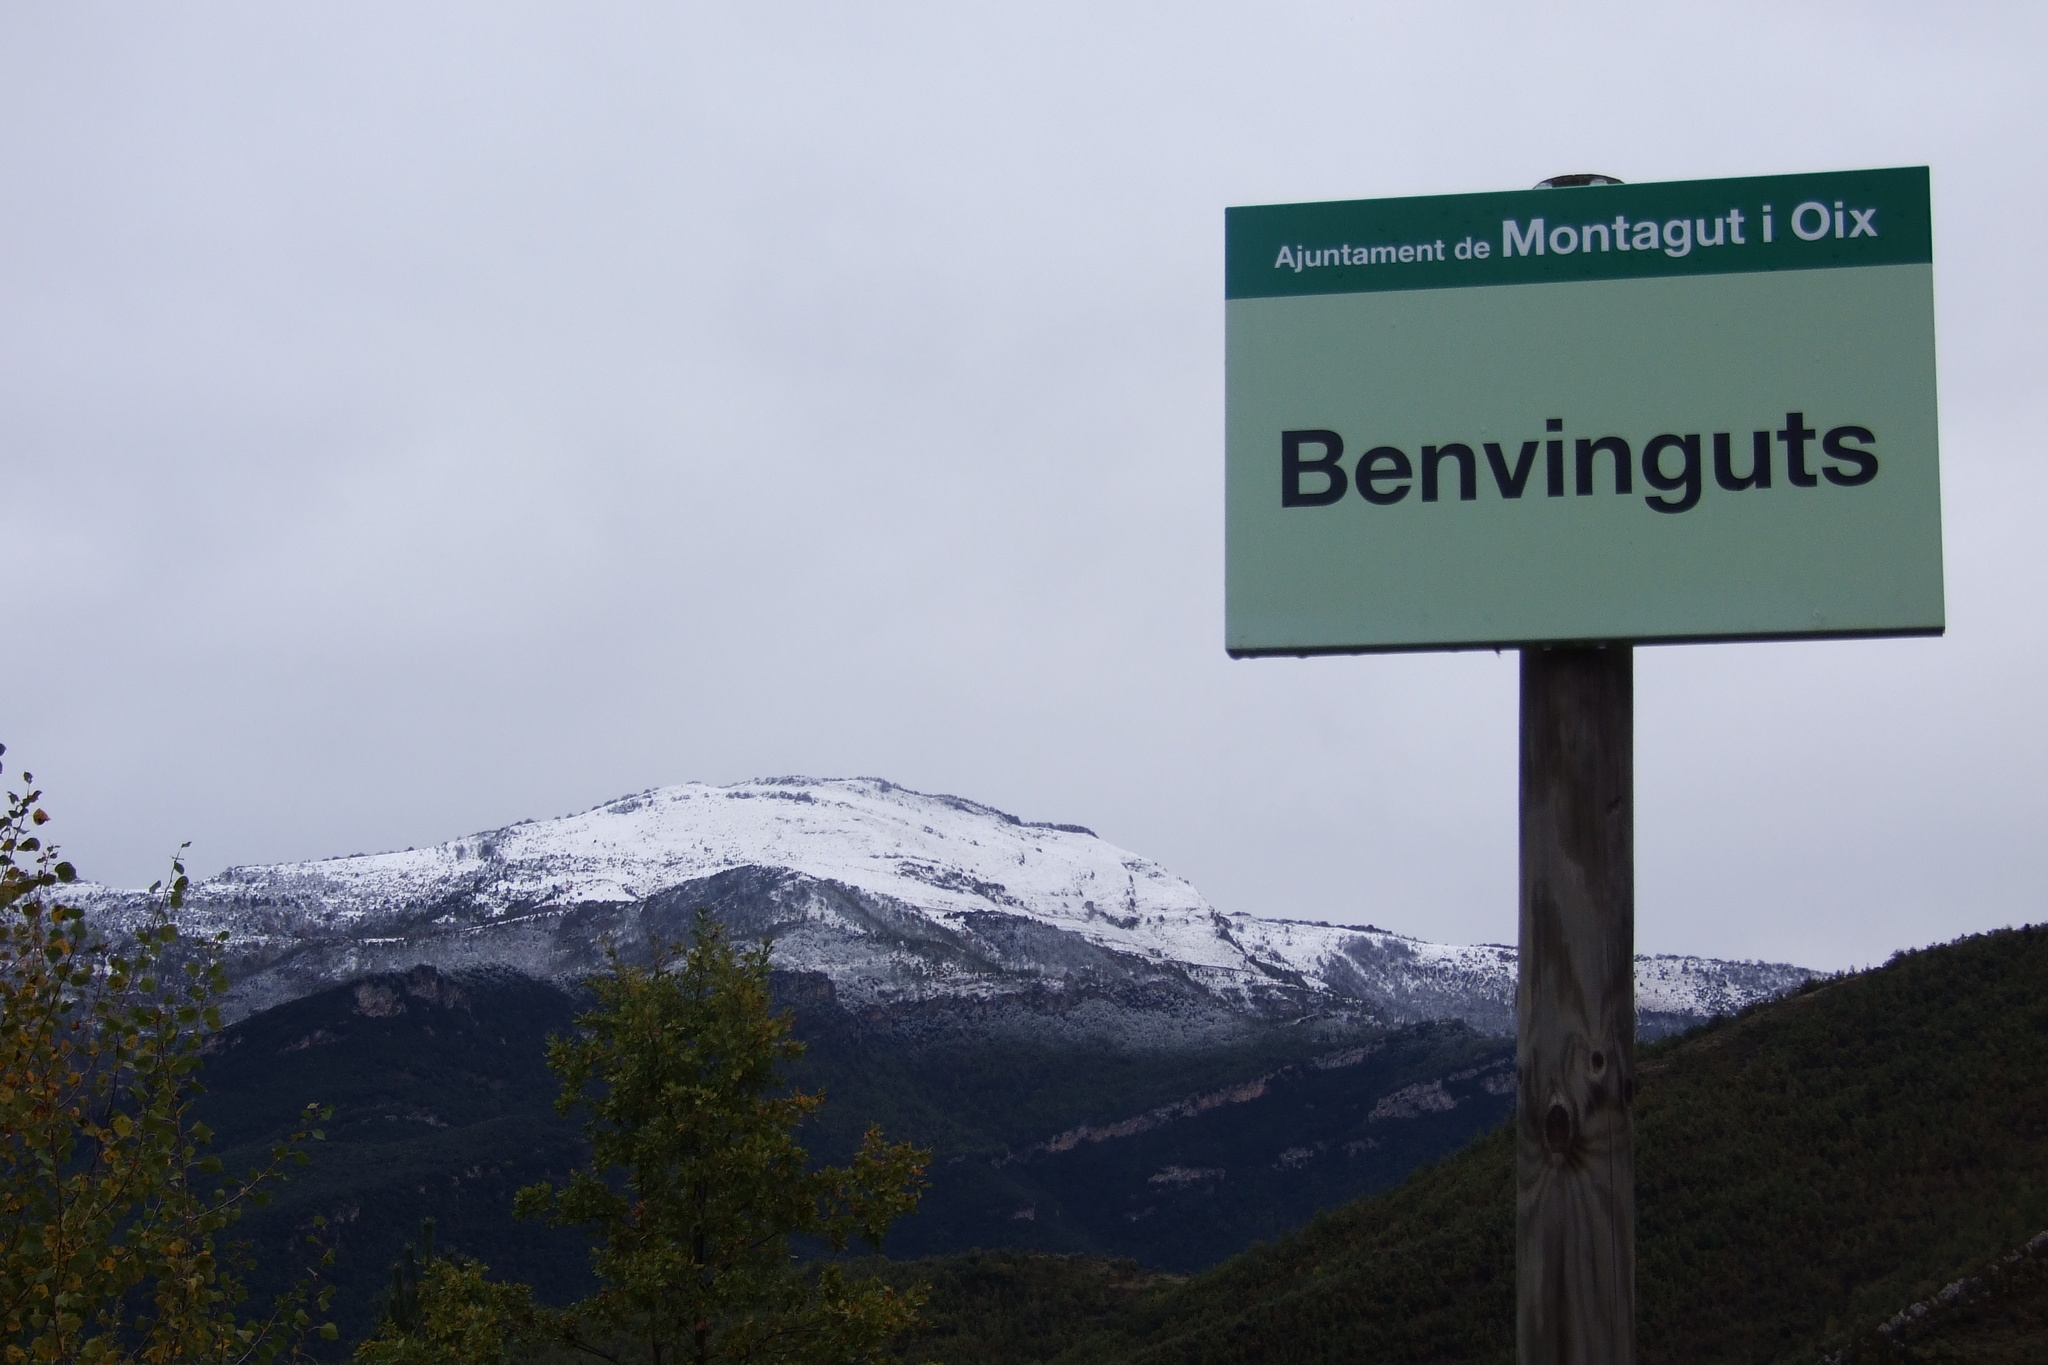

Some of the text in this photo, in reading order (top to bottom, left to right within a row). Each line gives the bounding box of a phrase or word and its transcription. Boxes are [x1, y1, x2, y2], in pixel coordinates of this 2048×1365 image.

[1274, 201, 1878, 273] Ajuntament de Montagut i Oix
[1281, 411, 1880, 515] Benvinguts
